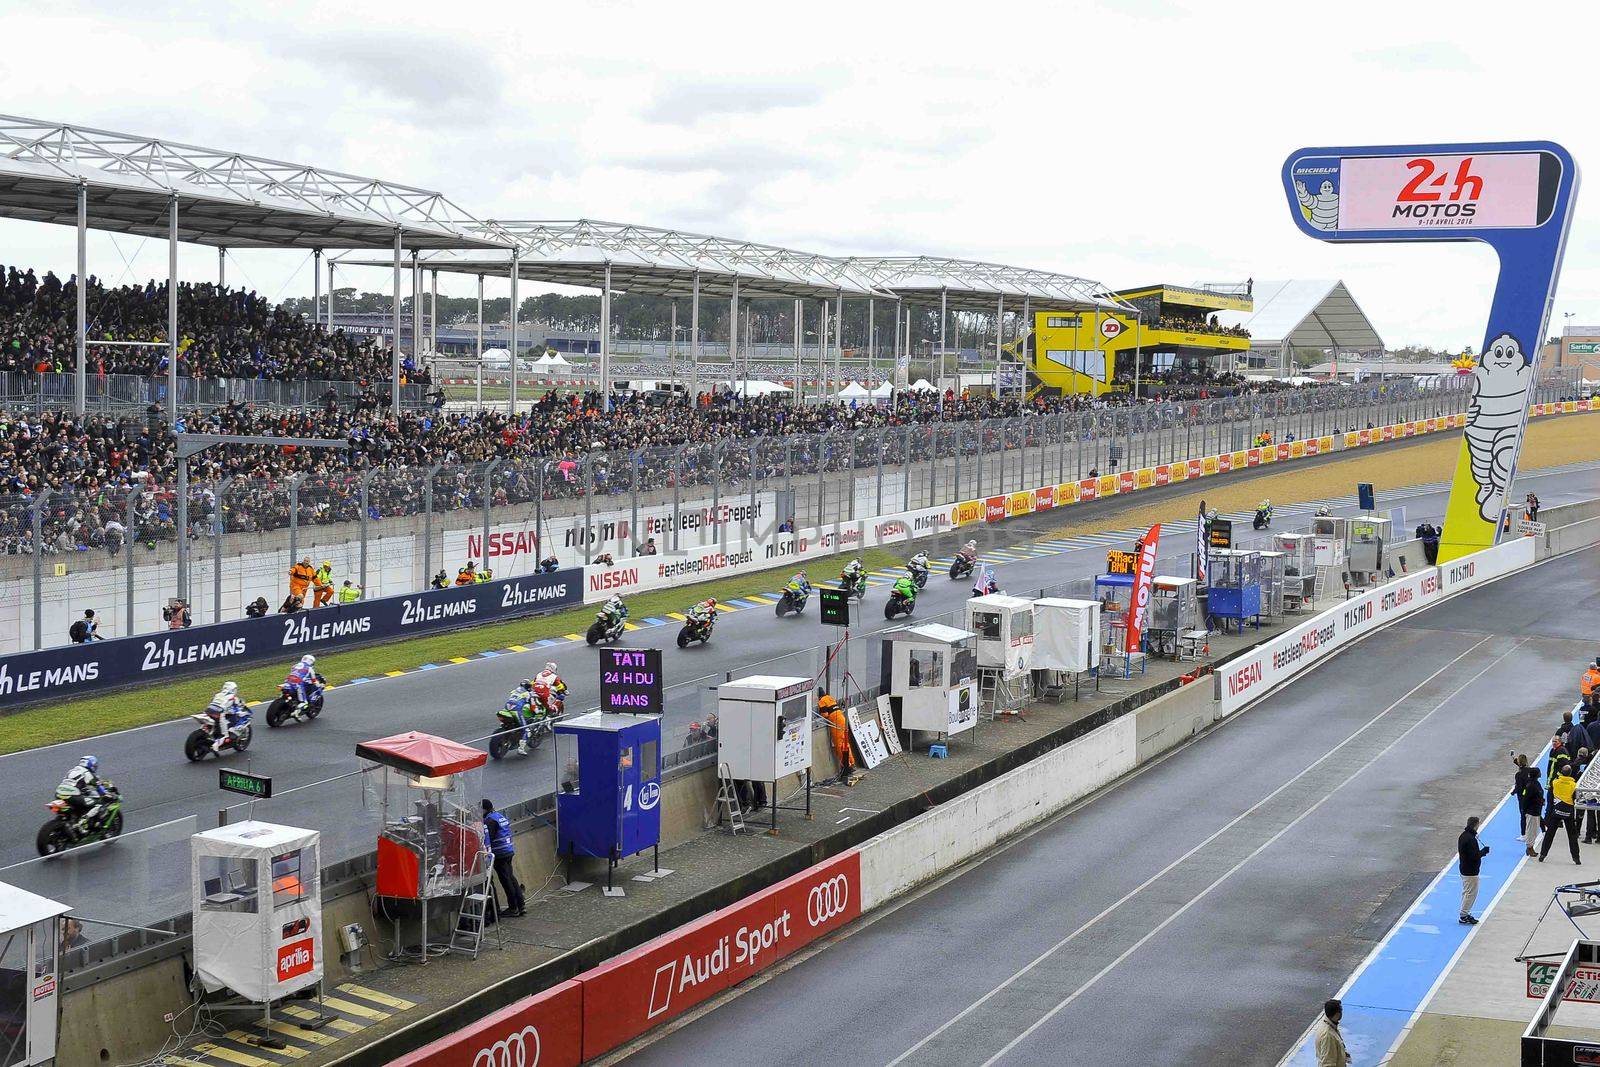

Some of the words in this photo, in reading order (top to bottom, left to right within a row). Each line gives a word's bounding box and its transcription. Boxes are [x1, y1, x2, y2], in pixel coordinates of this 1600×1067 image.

[1397, 157, 1484, 202] 24h
[1392, 203, 1477, 218] MOTOS
[1013, 497, 1030, 511] HELIX
[1060, 488, 1075, 500] HELIX
[647, 501, 762, 534] #eatleepRACErepeat
[959, 505, 978, 521] HELIX
[986, 505, 1004, 517] V-Power
[874, 521, 905, 538] NISSAN
[590, 567, 638, 590] NISSAN
[1134, 541, 1156, 630] MOTUL
[501, 582, 523, 608] 24h
[523, 588, 537, 602] LE
[537, 582, 567, 600] MANS
[400, 598, 425, 625] 24h
[426, 604, 442, 620] LE
[443, 599, 477, 618] MANS
[282, 616, 310, 646] 24h
[312, 622, 329, 641] LE
[332, 616, 371, 636] MANS
[141, 638, 175, 671] 24h
[177, 645, 198, 664] LE
[200, 637, 246, 659] MANS
[612, 652, 646, 667] TATI
[17, 671, 40, 692] LE
[44, 662, 99, 688] MANS
[604, 672, 620, 684] 24
[623, 672, 633, 684] H
[635, 673, 654, 685] DU
[1228, 660, 1262, 697] NISSAN
[610, 694, 649, 707] MANS
[226, 775, 254, 791] APRILIA
[255, 781, 261, 793] 6
[623, 784, 633, 811] 4
[280, 947, 310, 972] aprilia
[678, 936, 729, 994] Audi
[734, 909, 791, 965] Sport
[1530, 965, 1559, 984] 45
